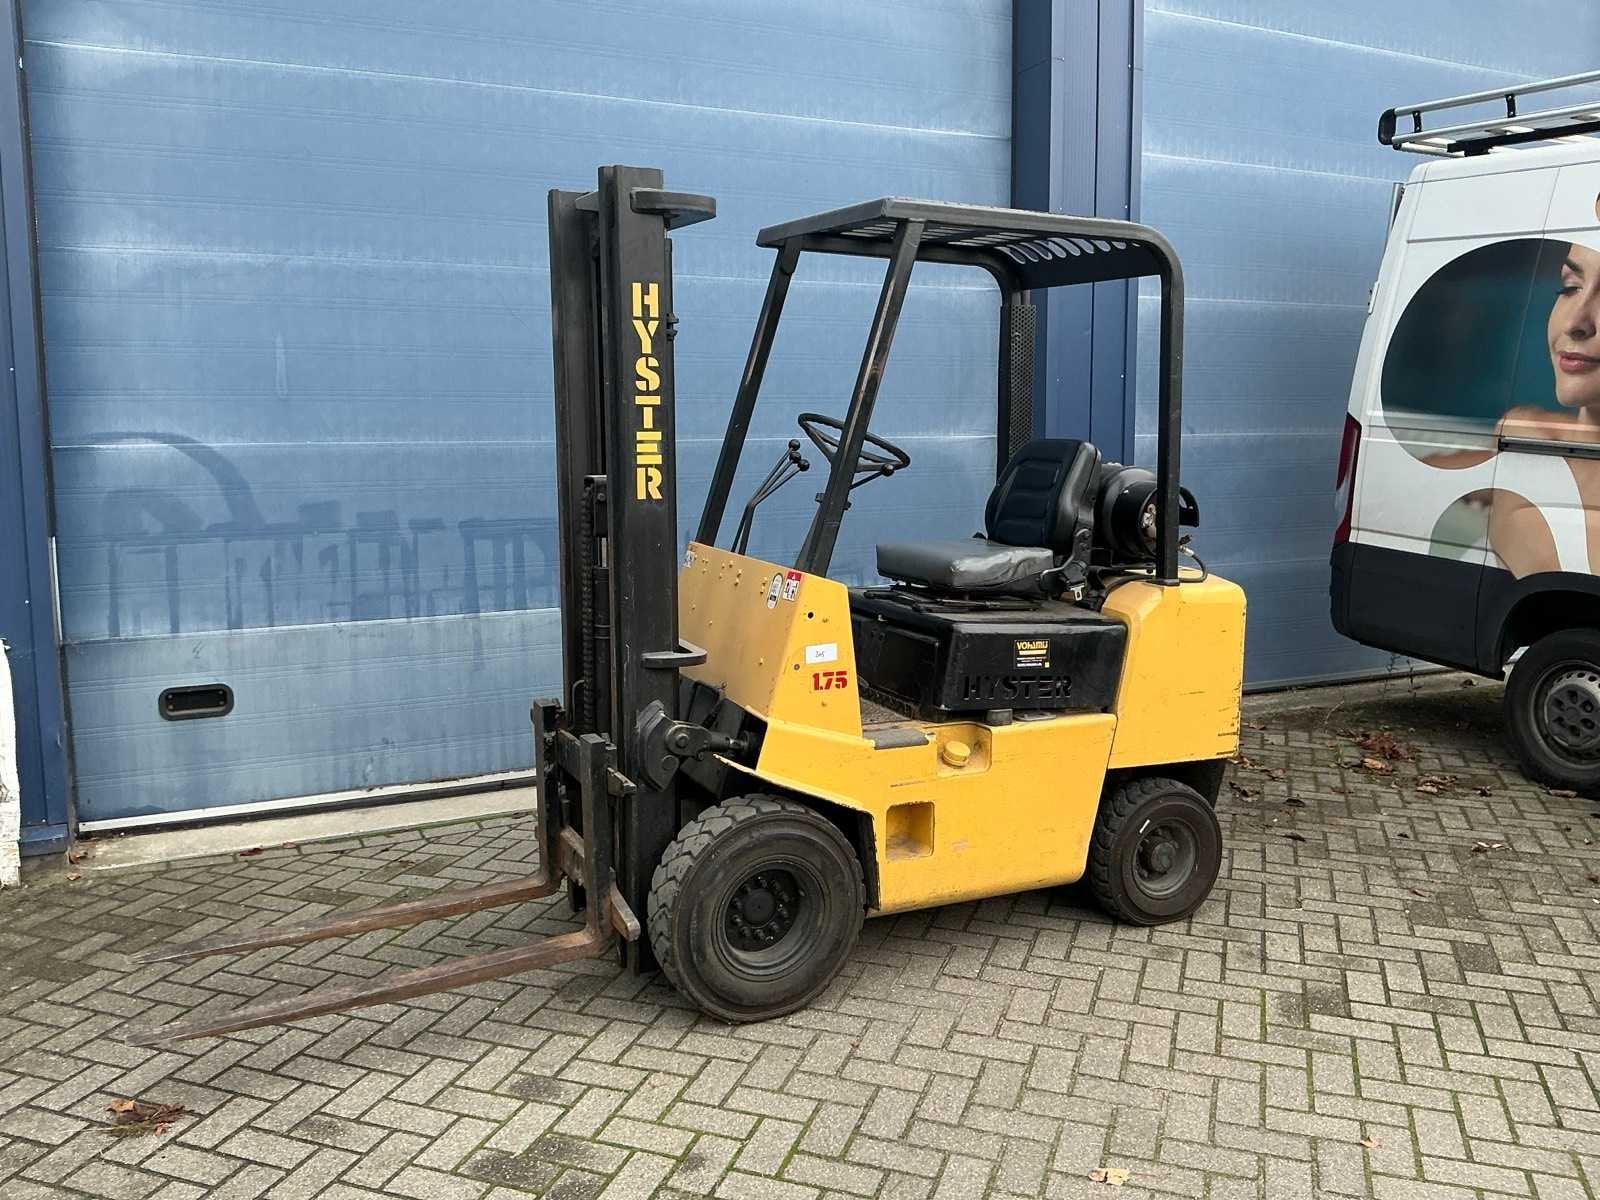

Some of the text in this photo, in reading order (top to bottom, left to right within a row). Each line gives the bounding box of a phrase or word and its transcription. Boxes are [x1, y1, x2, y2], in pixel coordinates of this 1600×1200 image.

[631, 282, 663, 500] HYSTER
[812, 670, 848, 691] 1.75
[963, 675, 1072, 701] HYSTER
